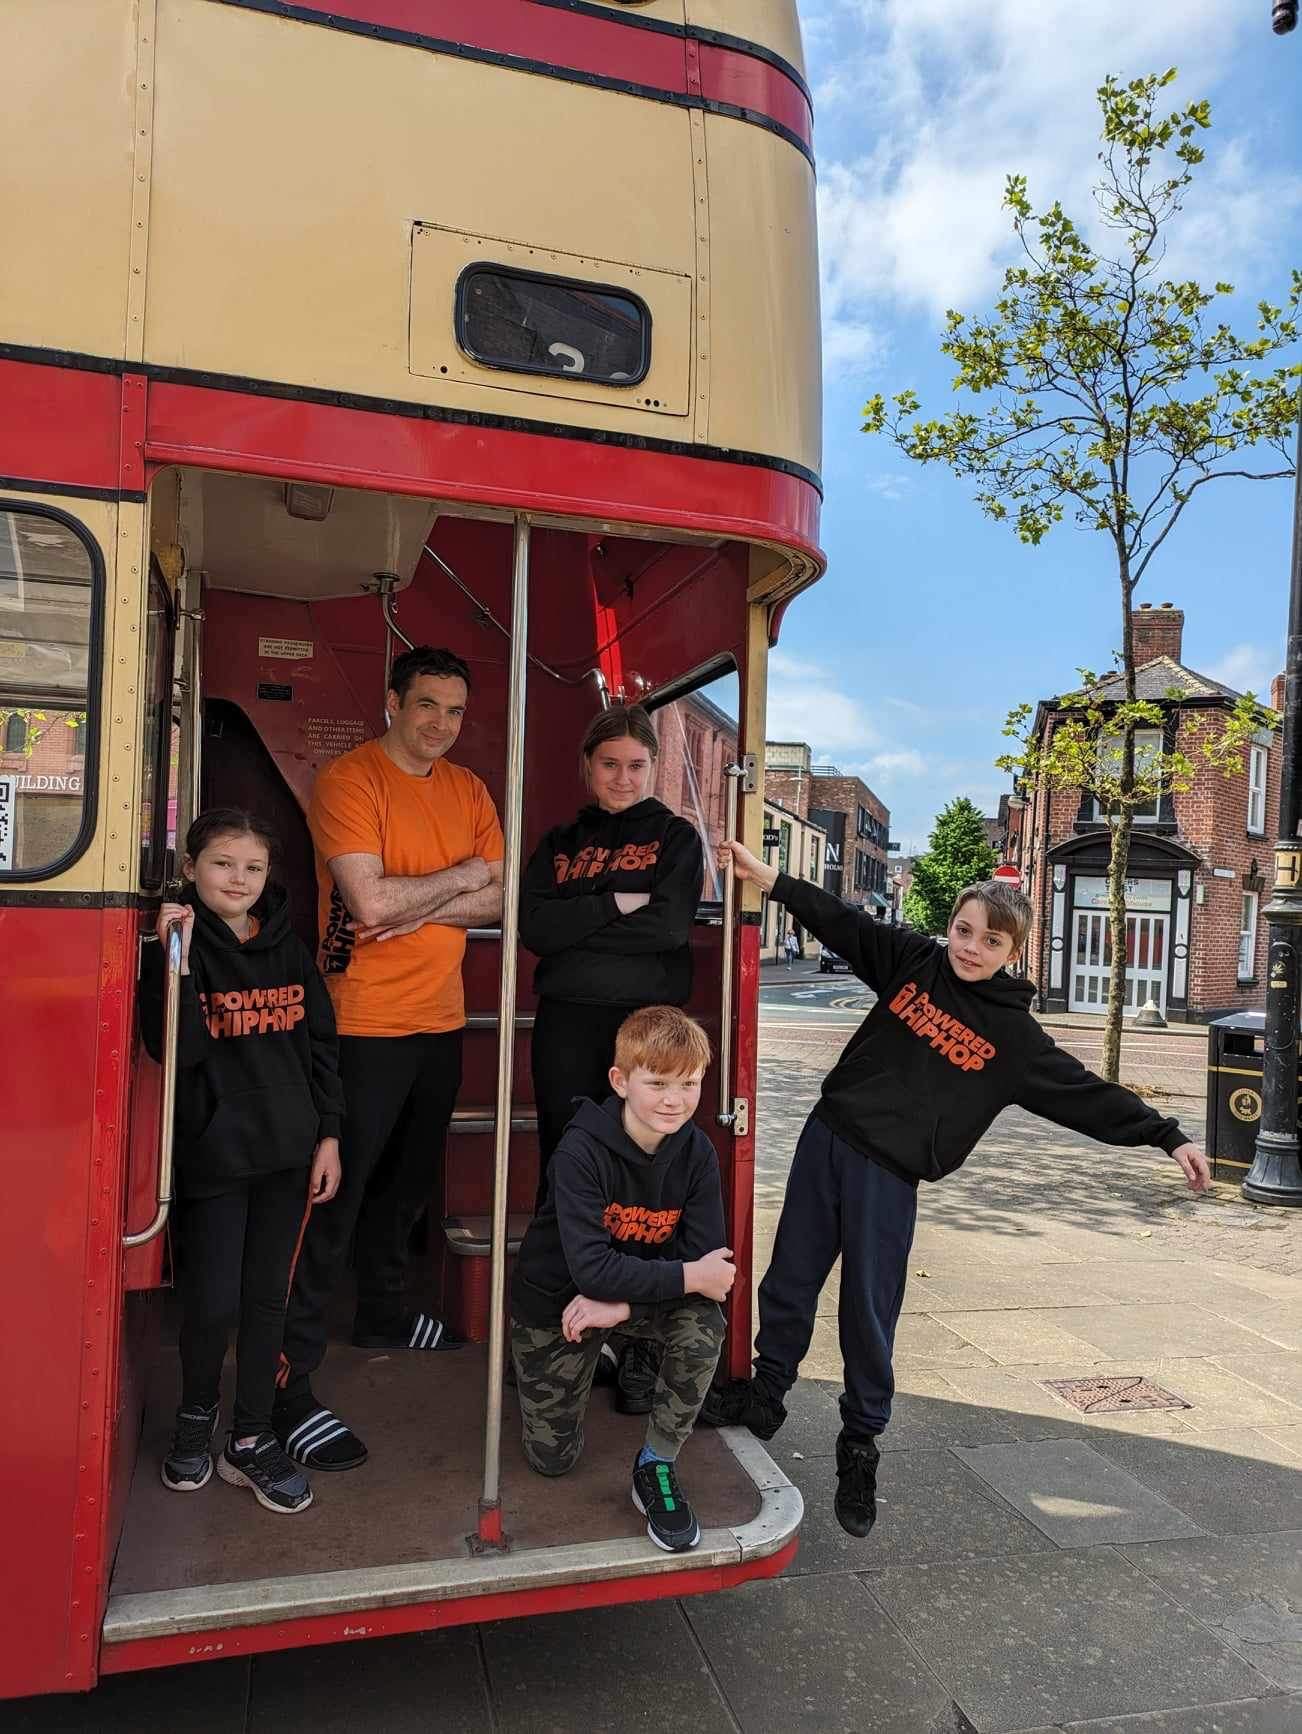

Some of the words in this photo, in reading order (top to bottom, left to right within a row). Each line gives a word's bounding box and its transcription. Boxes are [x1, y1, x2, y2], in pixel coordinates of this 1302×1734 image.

[899, 1003, 985, 1072] HIPHOP
[914, 991, 996, 1060] POWERED
[604, 1203, 682, 1228] POWERE
